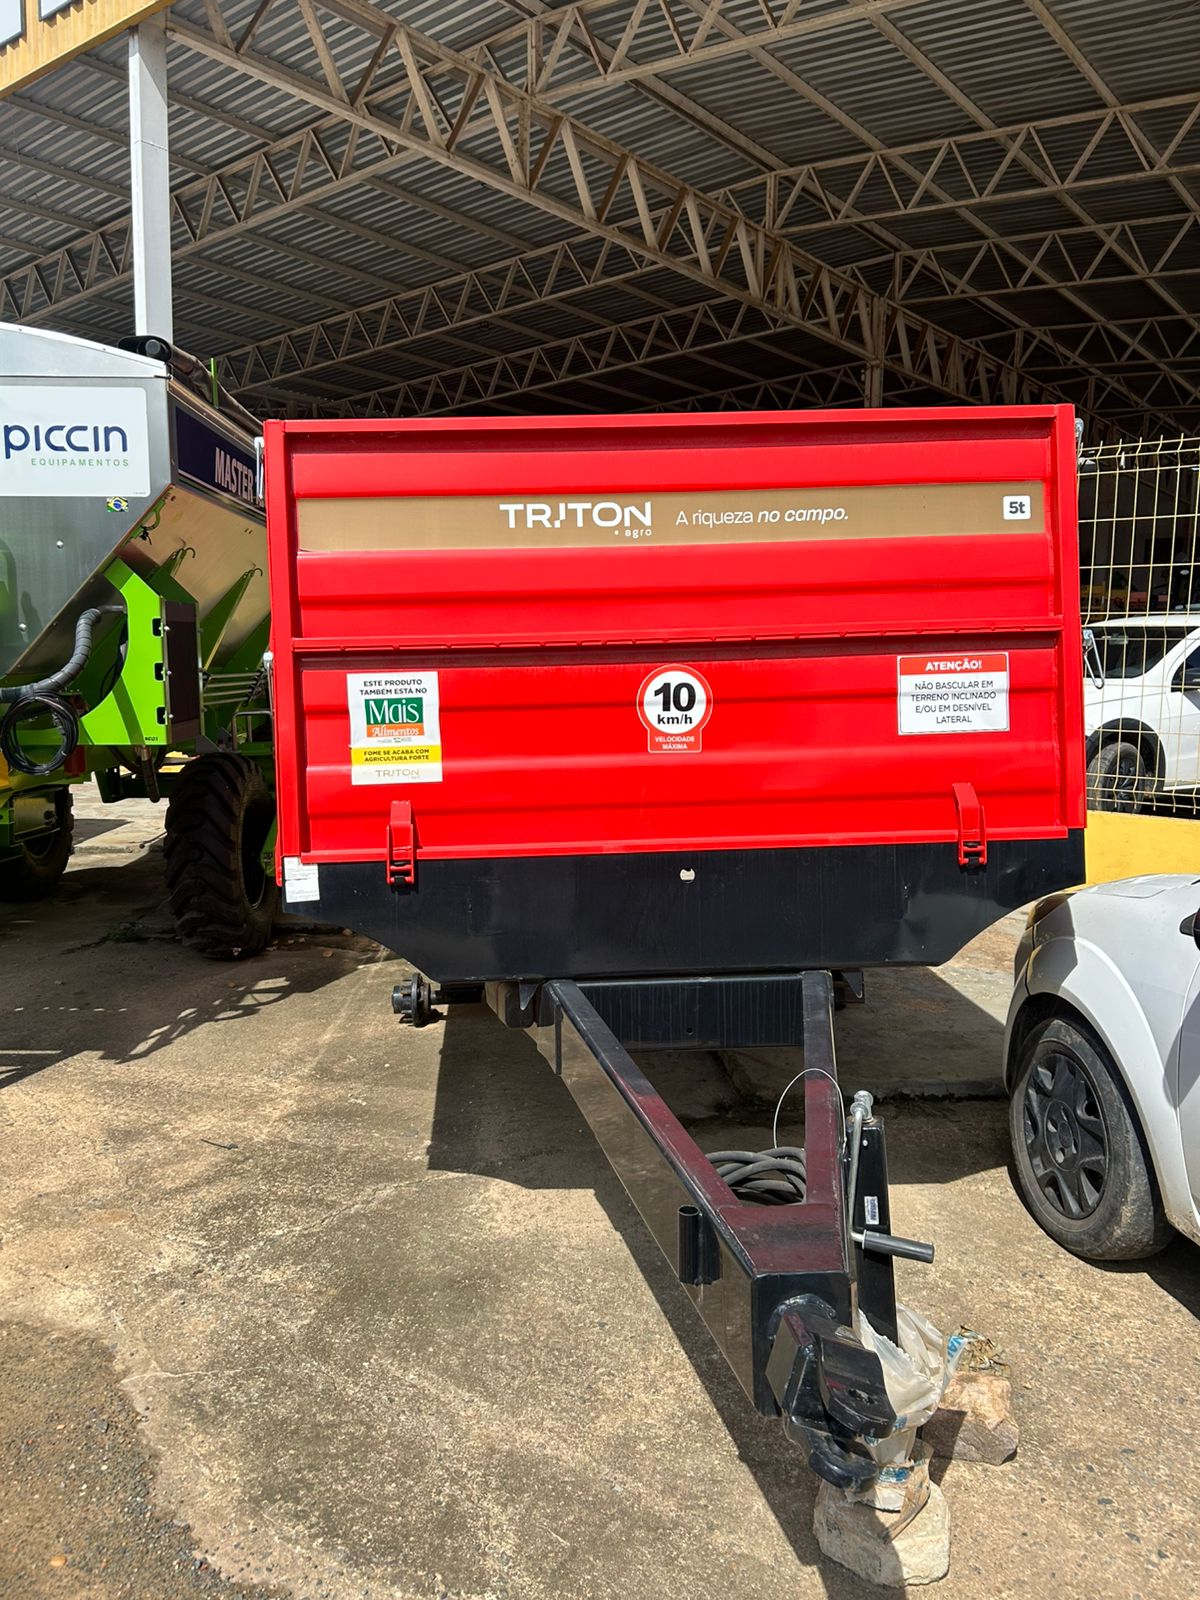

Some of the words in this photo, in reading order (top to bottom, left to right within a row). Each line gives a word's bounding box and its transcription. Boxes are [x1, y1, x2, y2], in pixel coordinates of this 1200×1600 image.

[31, 458, 129, 467] EQUIPAMENTOS
[215, 446, 254, 503] MASTER
[1009, 501, 1026, 514] 5t
[499, 501, 652, 528] TRITON
[675, 510, 689, 525] A
[692, 509, 754, 528] riqueza
[757, 510, 780, 523] no
[784, 507, 849, 525] campo.
[624, 529, 652, 539] agro
[925, 658, 982, 671] ATENÇÃO!
[914, 681, 934, 690] NÃO
[935, 681, 980, 690] BASCULAR
[981, 680, 994, 688] EM
[360, 688, 393, 696] TAMBÉM
[394, 687, 414, 695] ESTÁ
[654, 682, 696, 712] 10
[911, 693, 949, 702] TERRENO
[951, 691, 997, 700] INCLINADO
[369, 699, 420, 724] Mais
[915, 704, 937, 713] E/OU
[938, 704, 951, 712] EM
[952, 703, 992, 712] DESNÍVEL
[657, 714, 693, 724] km/h
[936, 715, 972, 724] LATERAL
[371, 724, 419, 737] Alimentos
